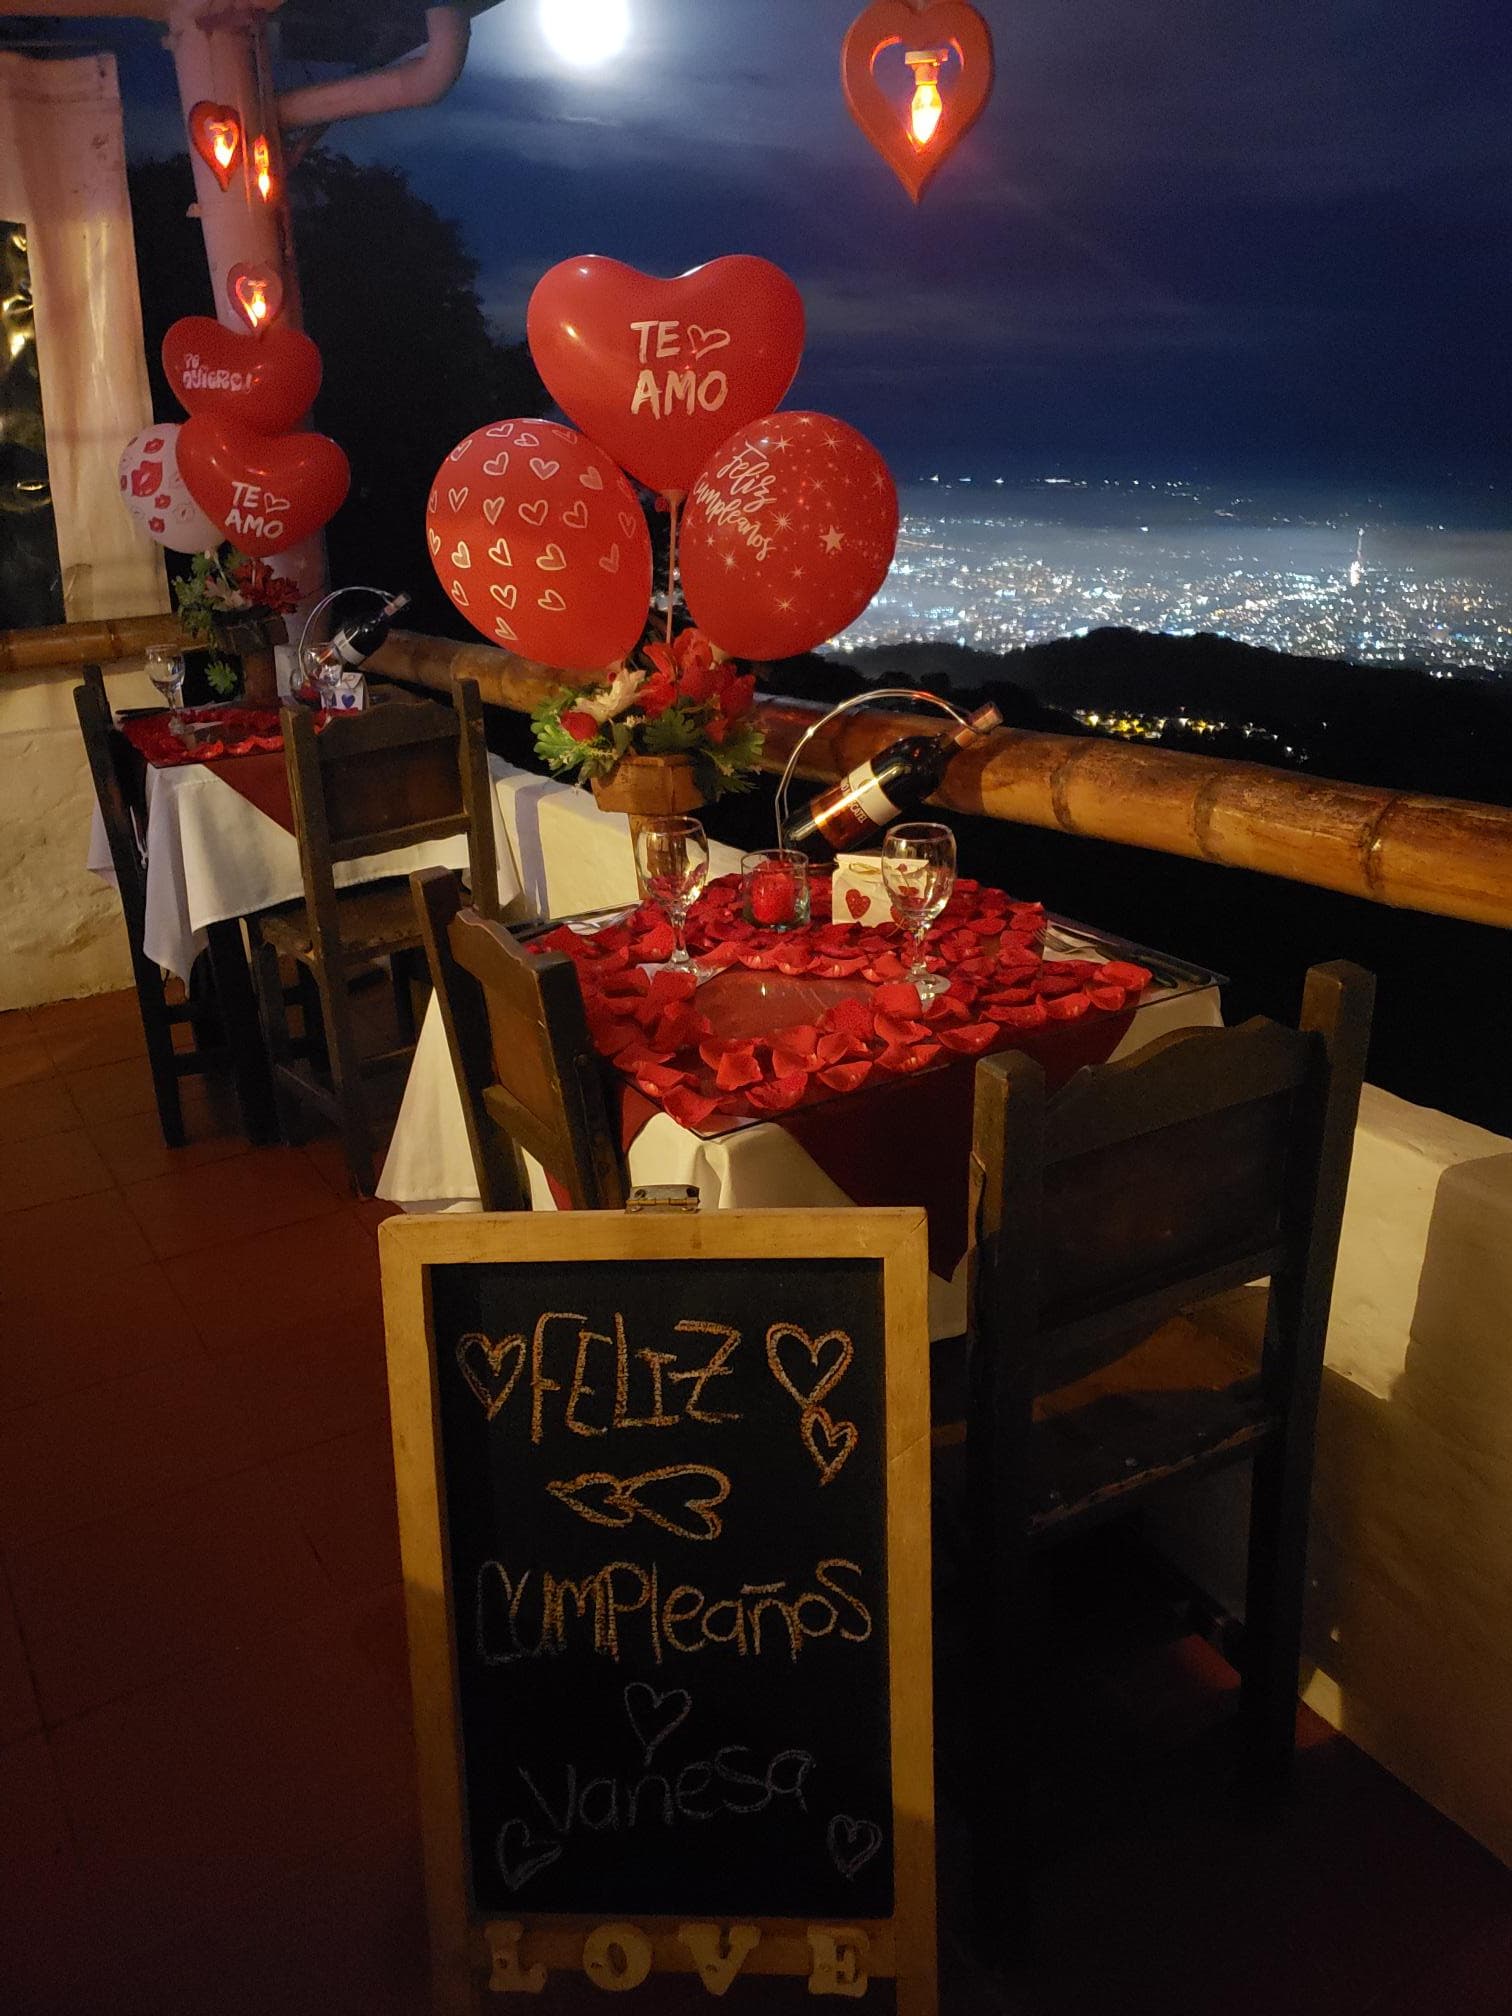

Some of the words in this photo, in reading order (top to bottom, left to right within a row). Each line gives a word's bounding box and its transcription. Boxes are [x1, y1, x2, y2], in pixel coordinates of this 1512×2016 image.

[630, 320, 681, 364] TE
[630, 369, 729, 420] AMO
[231, 481, 260, 509] TE
[716, 439, 778, 513] Feliz
[224, 509, 284, 539] AMO
[529, 1311, 744, 1445] FELIZ
[484, 1920, 870, 1998] LOVE
